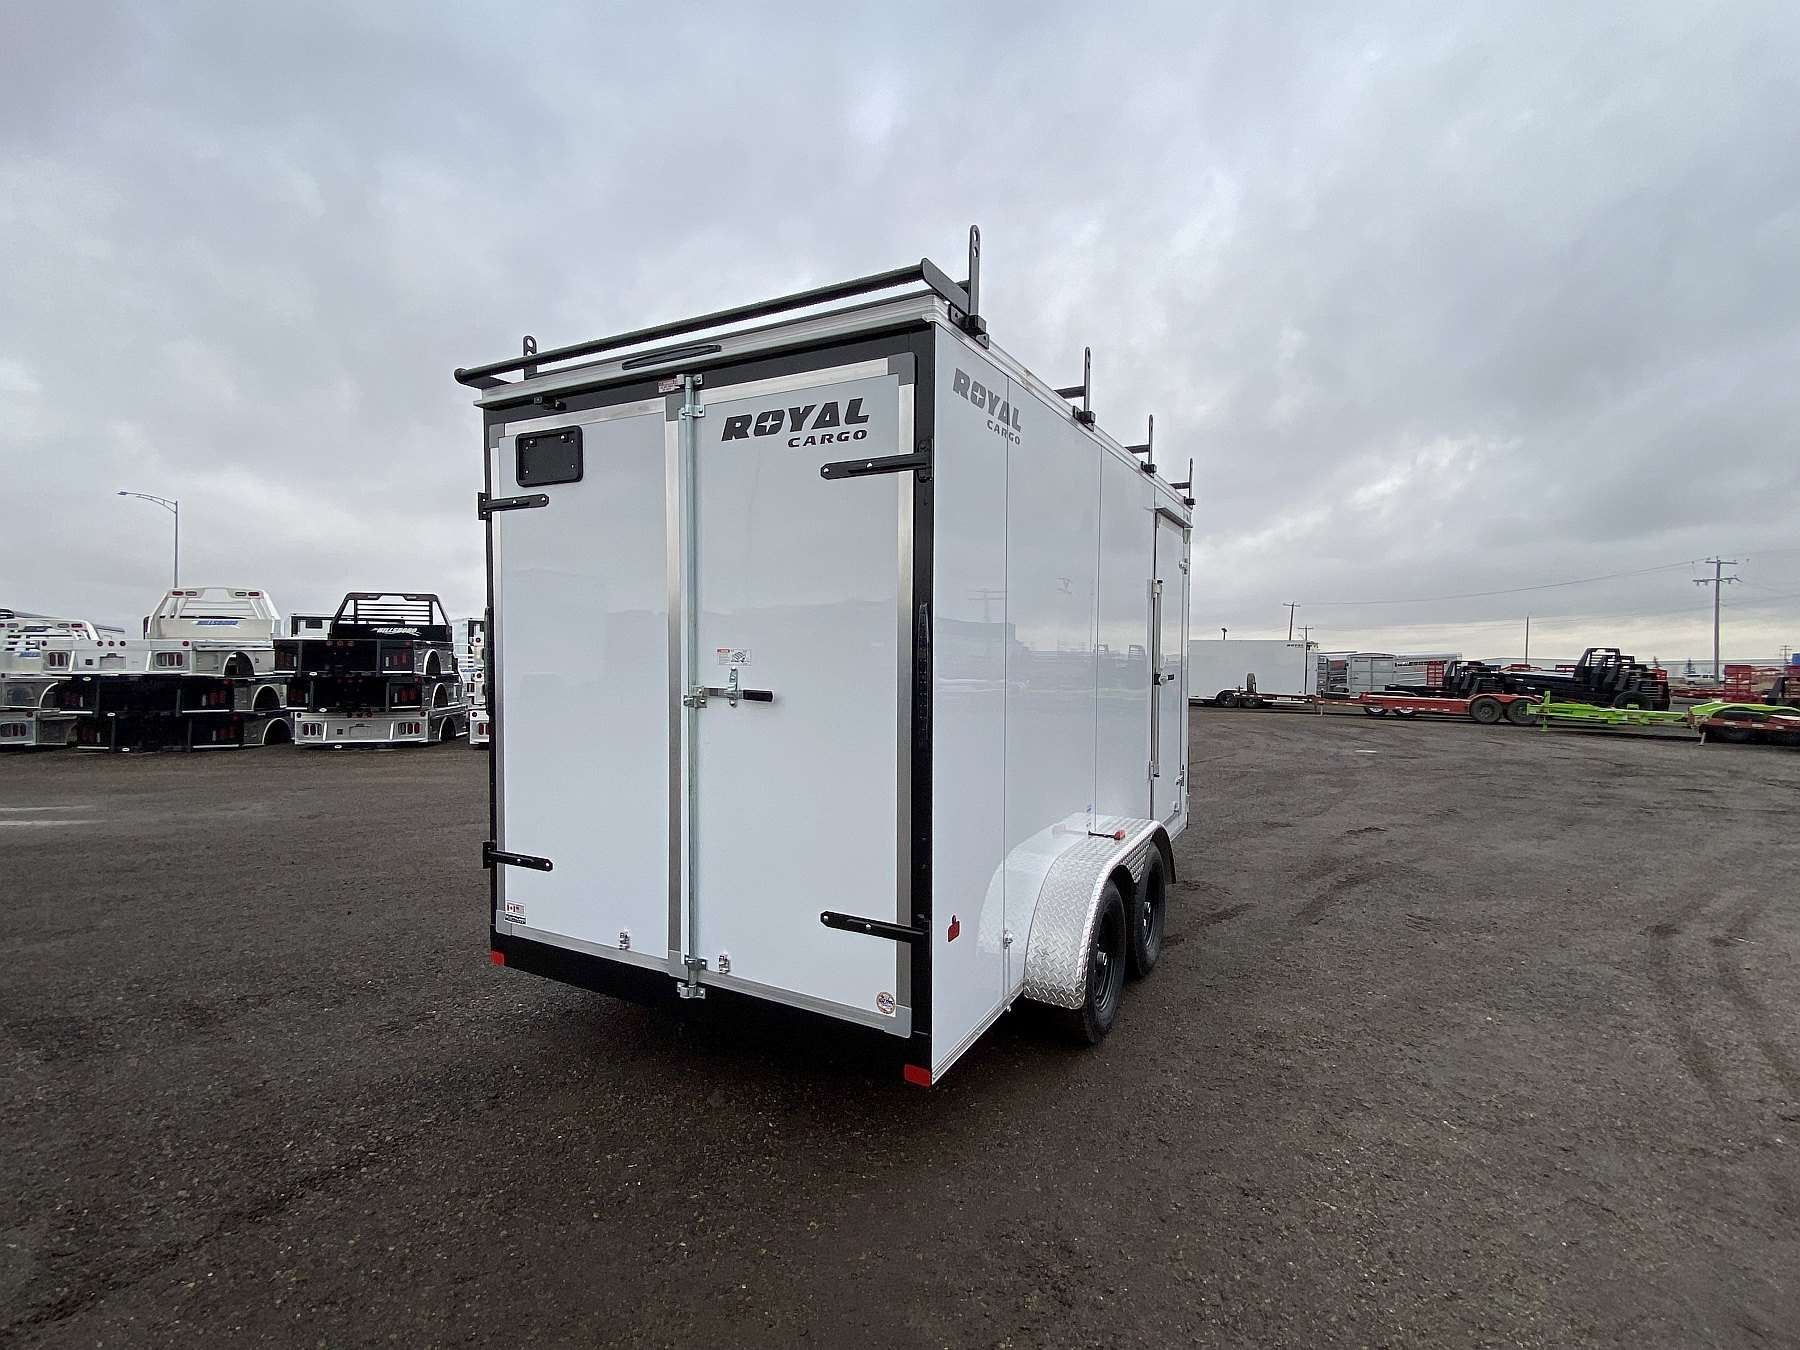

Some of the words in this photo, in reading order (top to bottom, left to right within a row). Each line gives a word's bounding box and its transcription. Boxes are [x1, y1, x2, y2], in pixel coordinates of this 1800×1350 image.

[953, 368, 1021, 432] ROYAL
[721, 398, 869, 441] ROYAL
[987, 420, 1021, 445] CARGO
[788, 429, 867, 447] CARGO
